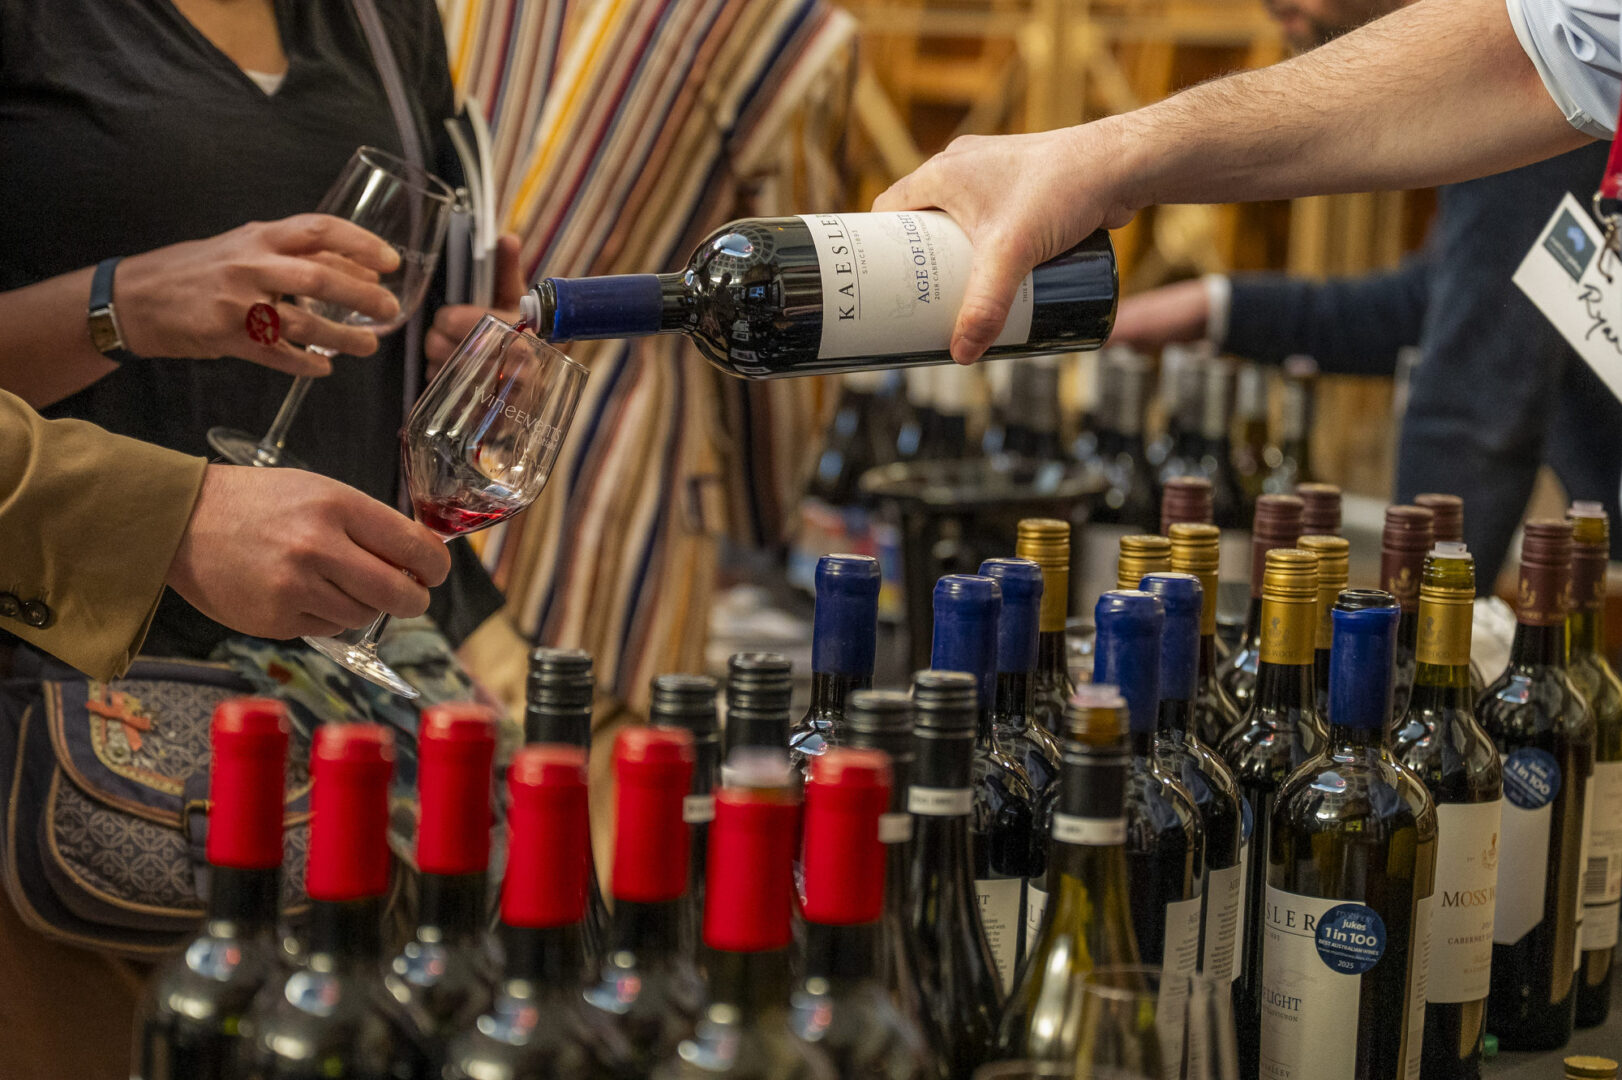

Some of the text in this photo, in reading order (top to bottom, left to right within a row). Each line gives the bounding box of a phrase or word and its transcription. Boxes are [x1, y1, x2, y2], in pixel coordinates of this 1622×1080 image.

[858, 249, 868, 275] SINCE
[911, 246, 926, 266] OF
[927, 243, 939, 281] CABERNET
[915, 269, 930, 304] AGE
[1529, 773, 1551, 795] 100
[1441, 888, 1488, 908] MOSS
[1342, 918, 1367, 932] jukes
[1325, 927, 1377, 947] 1 in 100
[1266, 988, 1302, 1012] LIGHT
